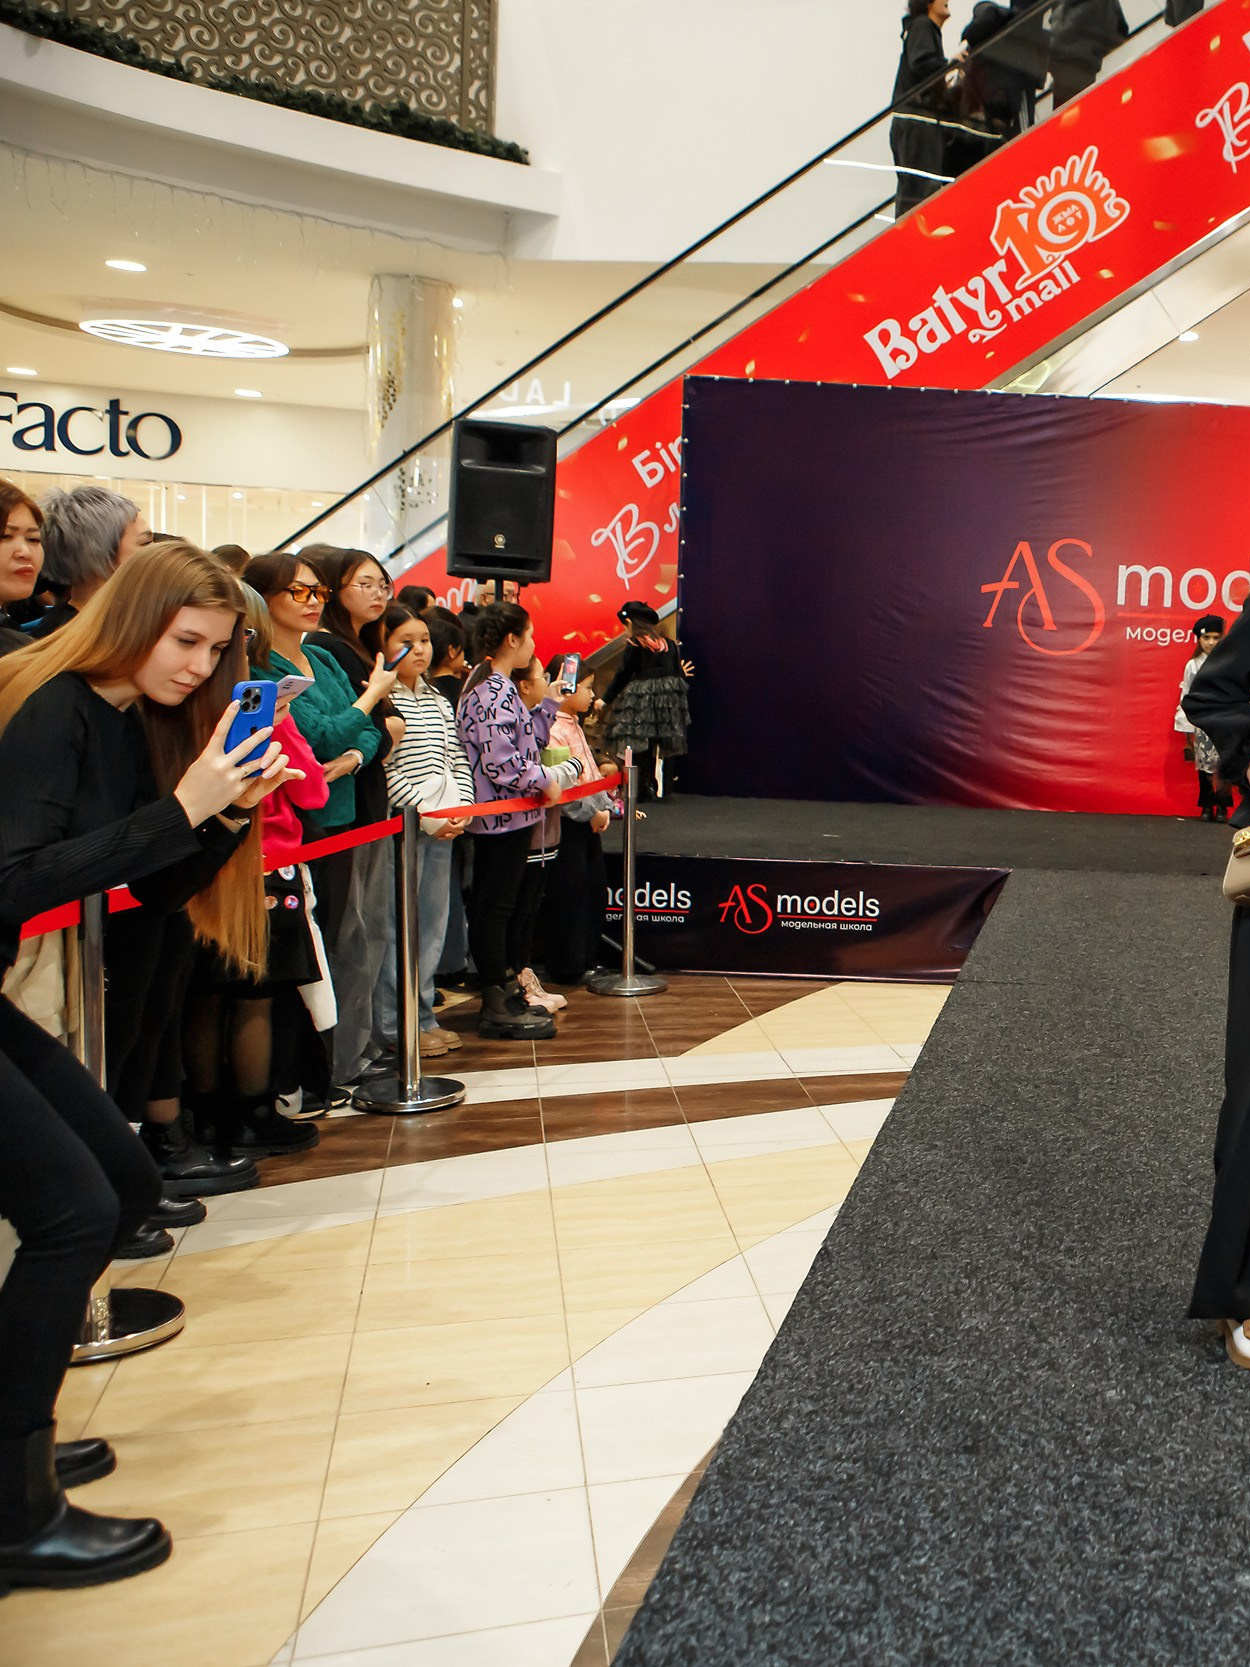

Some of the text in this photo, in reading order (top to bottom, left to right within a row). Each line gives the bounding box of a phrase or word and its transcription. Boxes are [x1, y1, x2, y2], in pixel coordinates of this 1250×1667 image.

[863, 258, 1014, 380] Batyr
[1004, 260, 1081, 322] mall
[980, 538, 1106, 656] AS
[651, 915, 685, 923] школа
[718, 883, 880, 935] AS models
[781, 920, 873, 931] модельная школа
